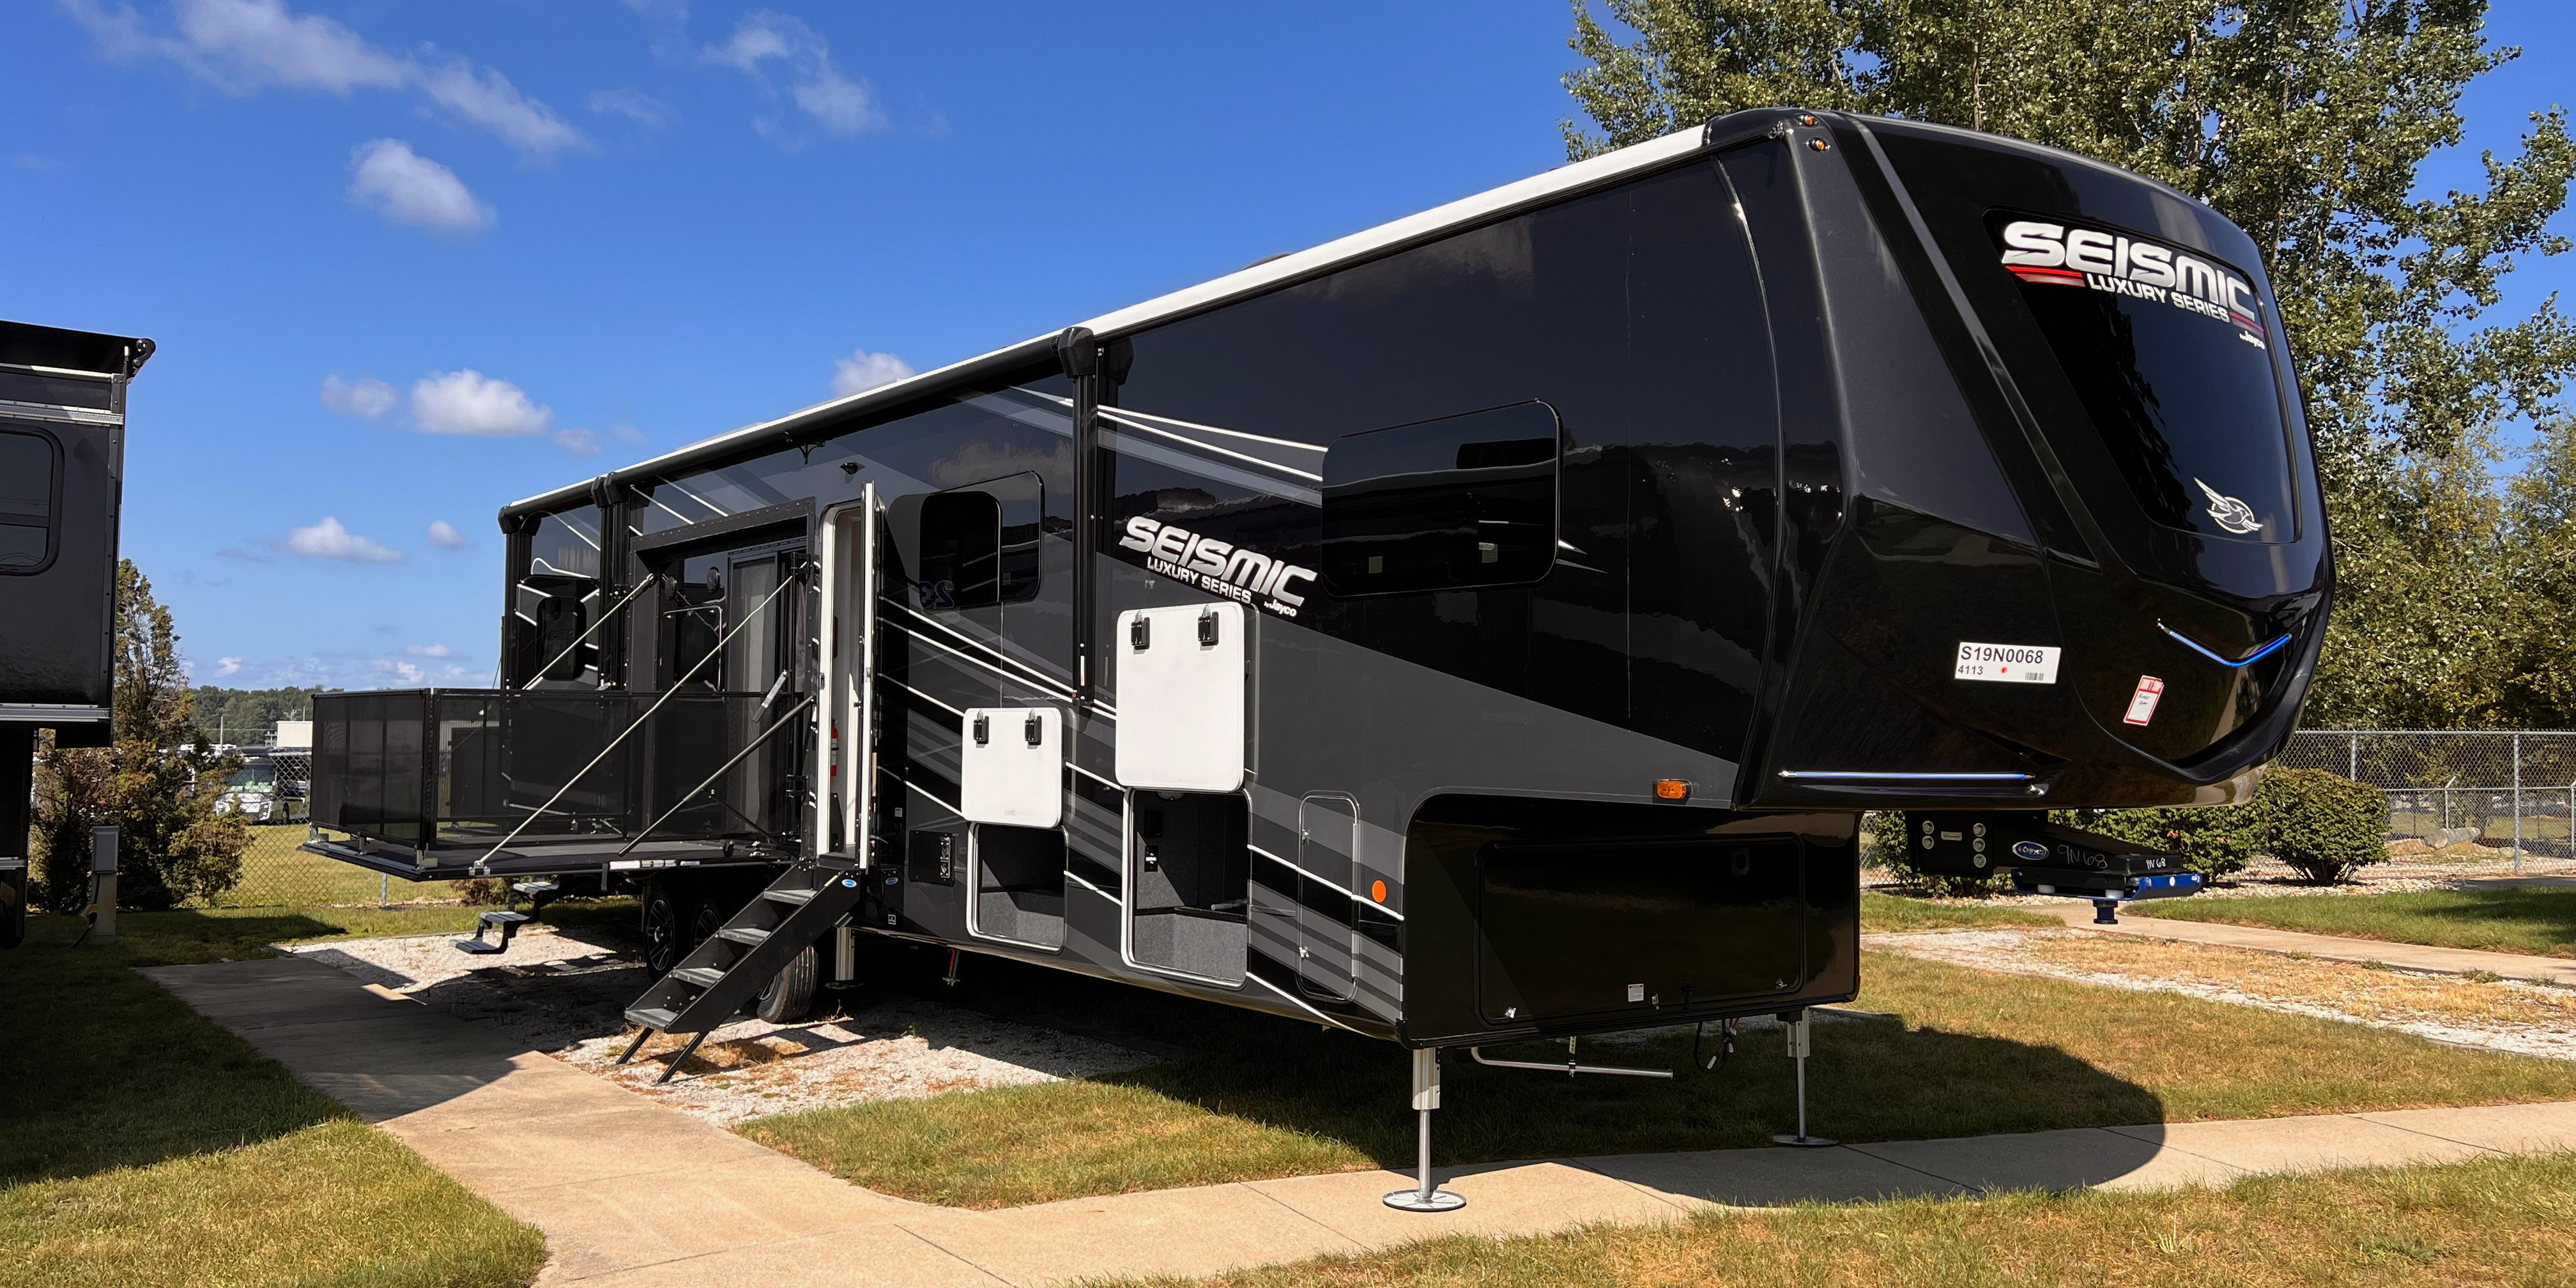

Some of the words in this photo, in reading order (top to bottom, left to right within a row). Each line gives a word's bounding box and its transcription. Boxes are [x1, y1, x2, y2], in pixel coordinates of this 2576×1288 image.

[2002, 221, 2255, 321] SEISMIC
[2087, 273, 2166, 304] LUXURY
[2171, 291, 2230, 323] SERIES
[1119, 516, 1318, 607] SEISMIC
[1147, 556, 1200, 585] LUXURY
[1201, 577, 1252, 604] SERIES
[1269, 599, 1297, 617] Jayco
[1958, 664, 1984, 675] 4113
[1960, 645, 2044, 664] S19N0068
[2057, 844, 2108, 869] 9N68
